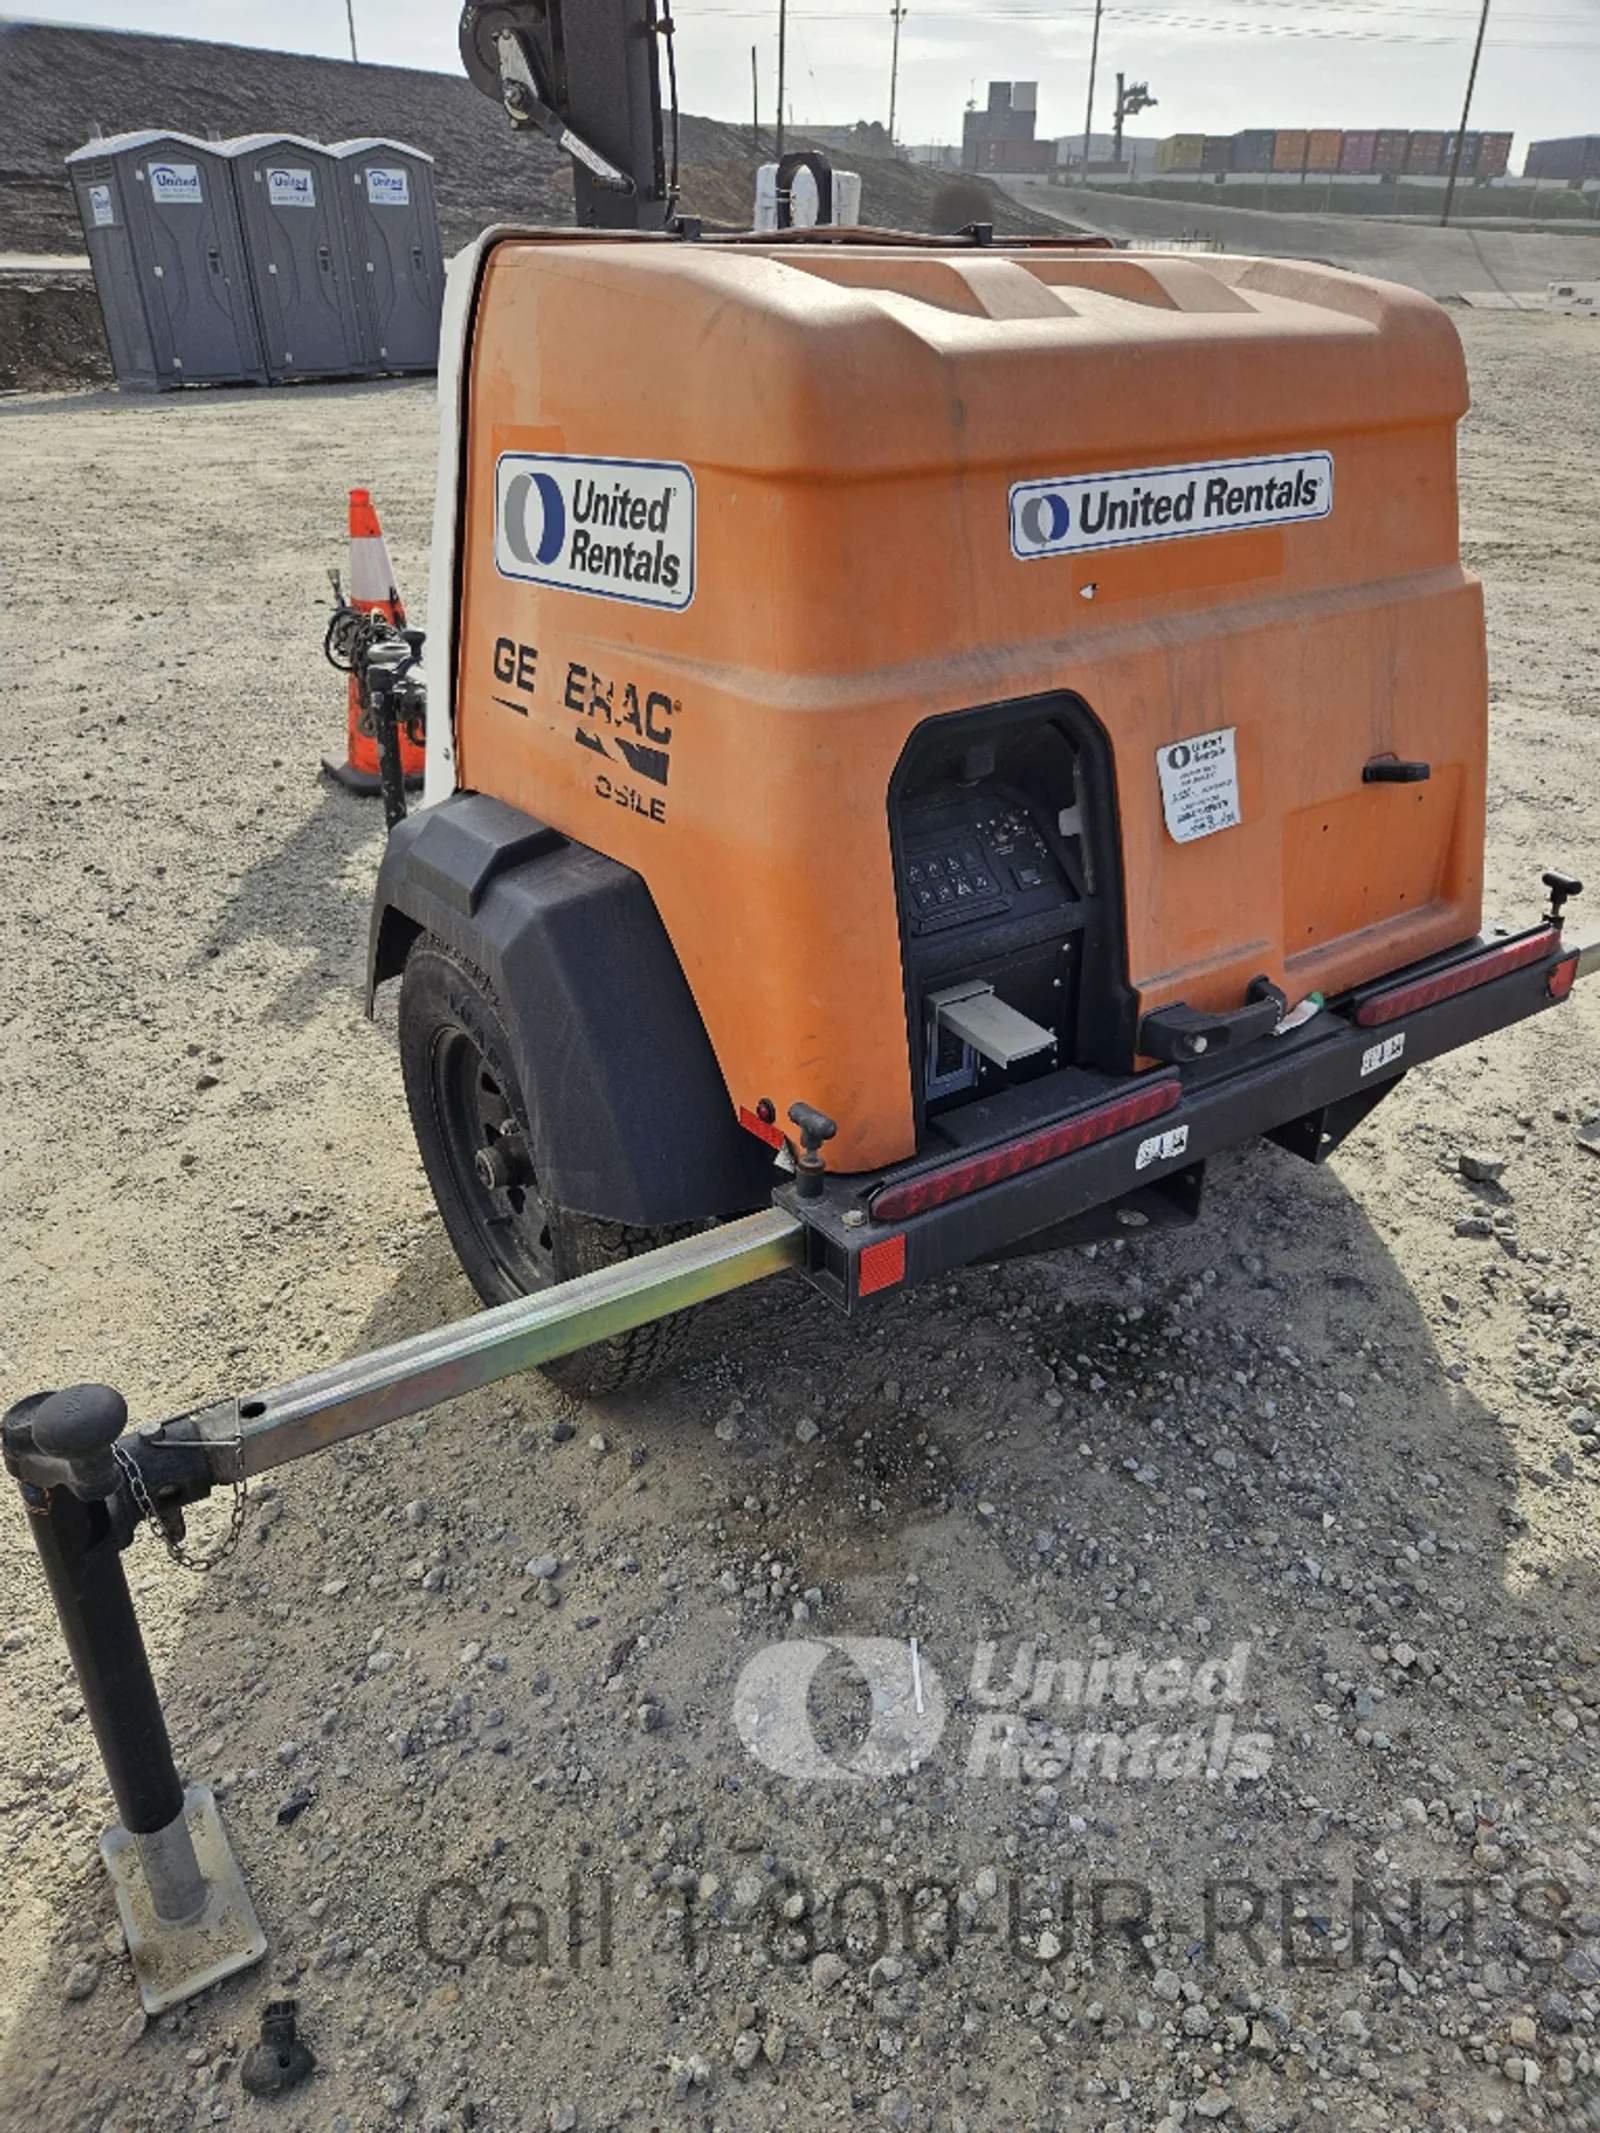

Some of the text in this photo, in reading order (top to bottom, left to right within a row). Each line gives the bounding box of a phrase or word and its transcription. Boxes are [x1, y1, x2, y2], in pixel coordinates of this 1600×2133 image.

[572, 479, 673, 534] United
[1078, 468, 1320, 534] United Rentals
[568, 529, 681, 589] Rentals
